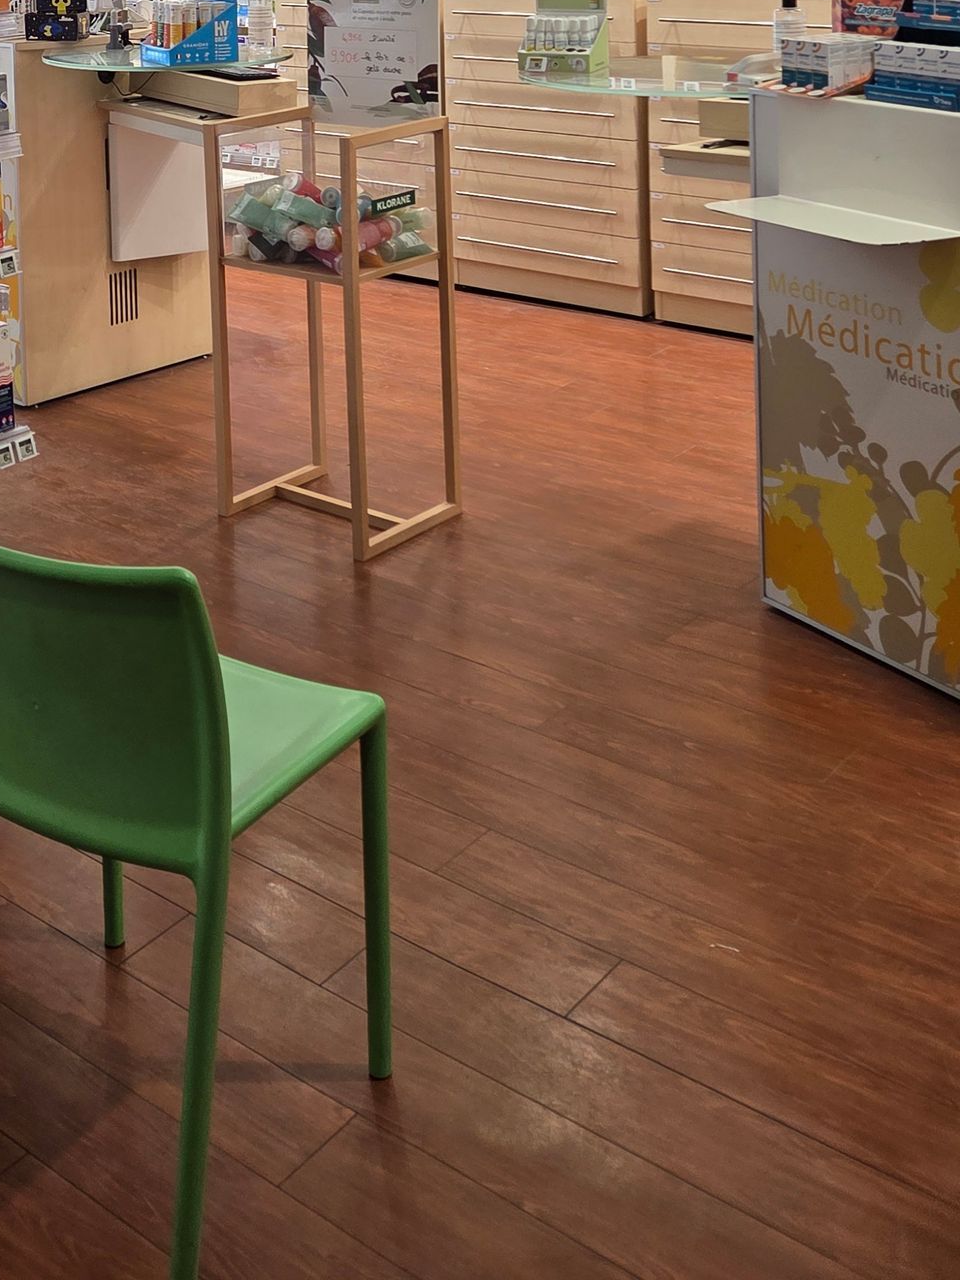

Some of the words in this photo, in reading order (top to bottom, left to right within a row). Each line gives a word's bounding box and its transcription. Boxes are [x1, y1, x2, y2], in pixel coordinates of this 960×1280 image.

[214, 21, 229, 36] HY
[376, 194, 411, 211] KLORANE
[768, 270, 903, 325] Médication
